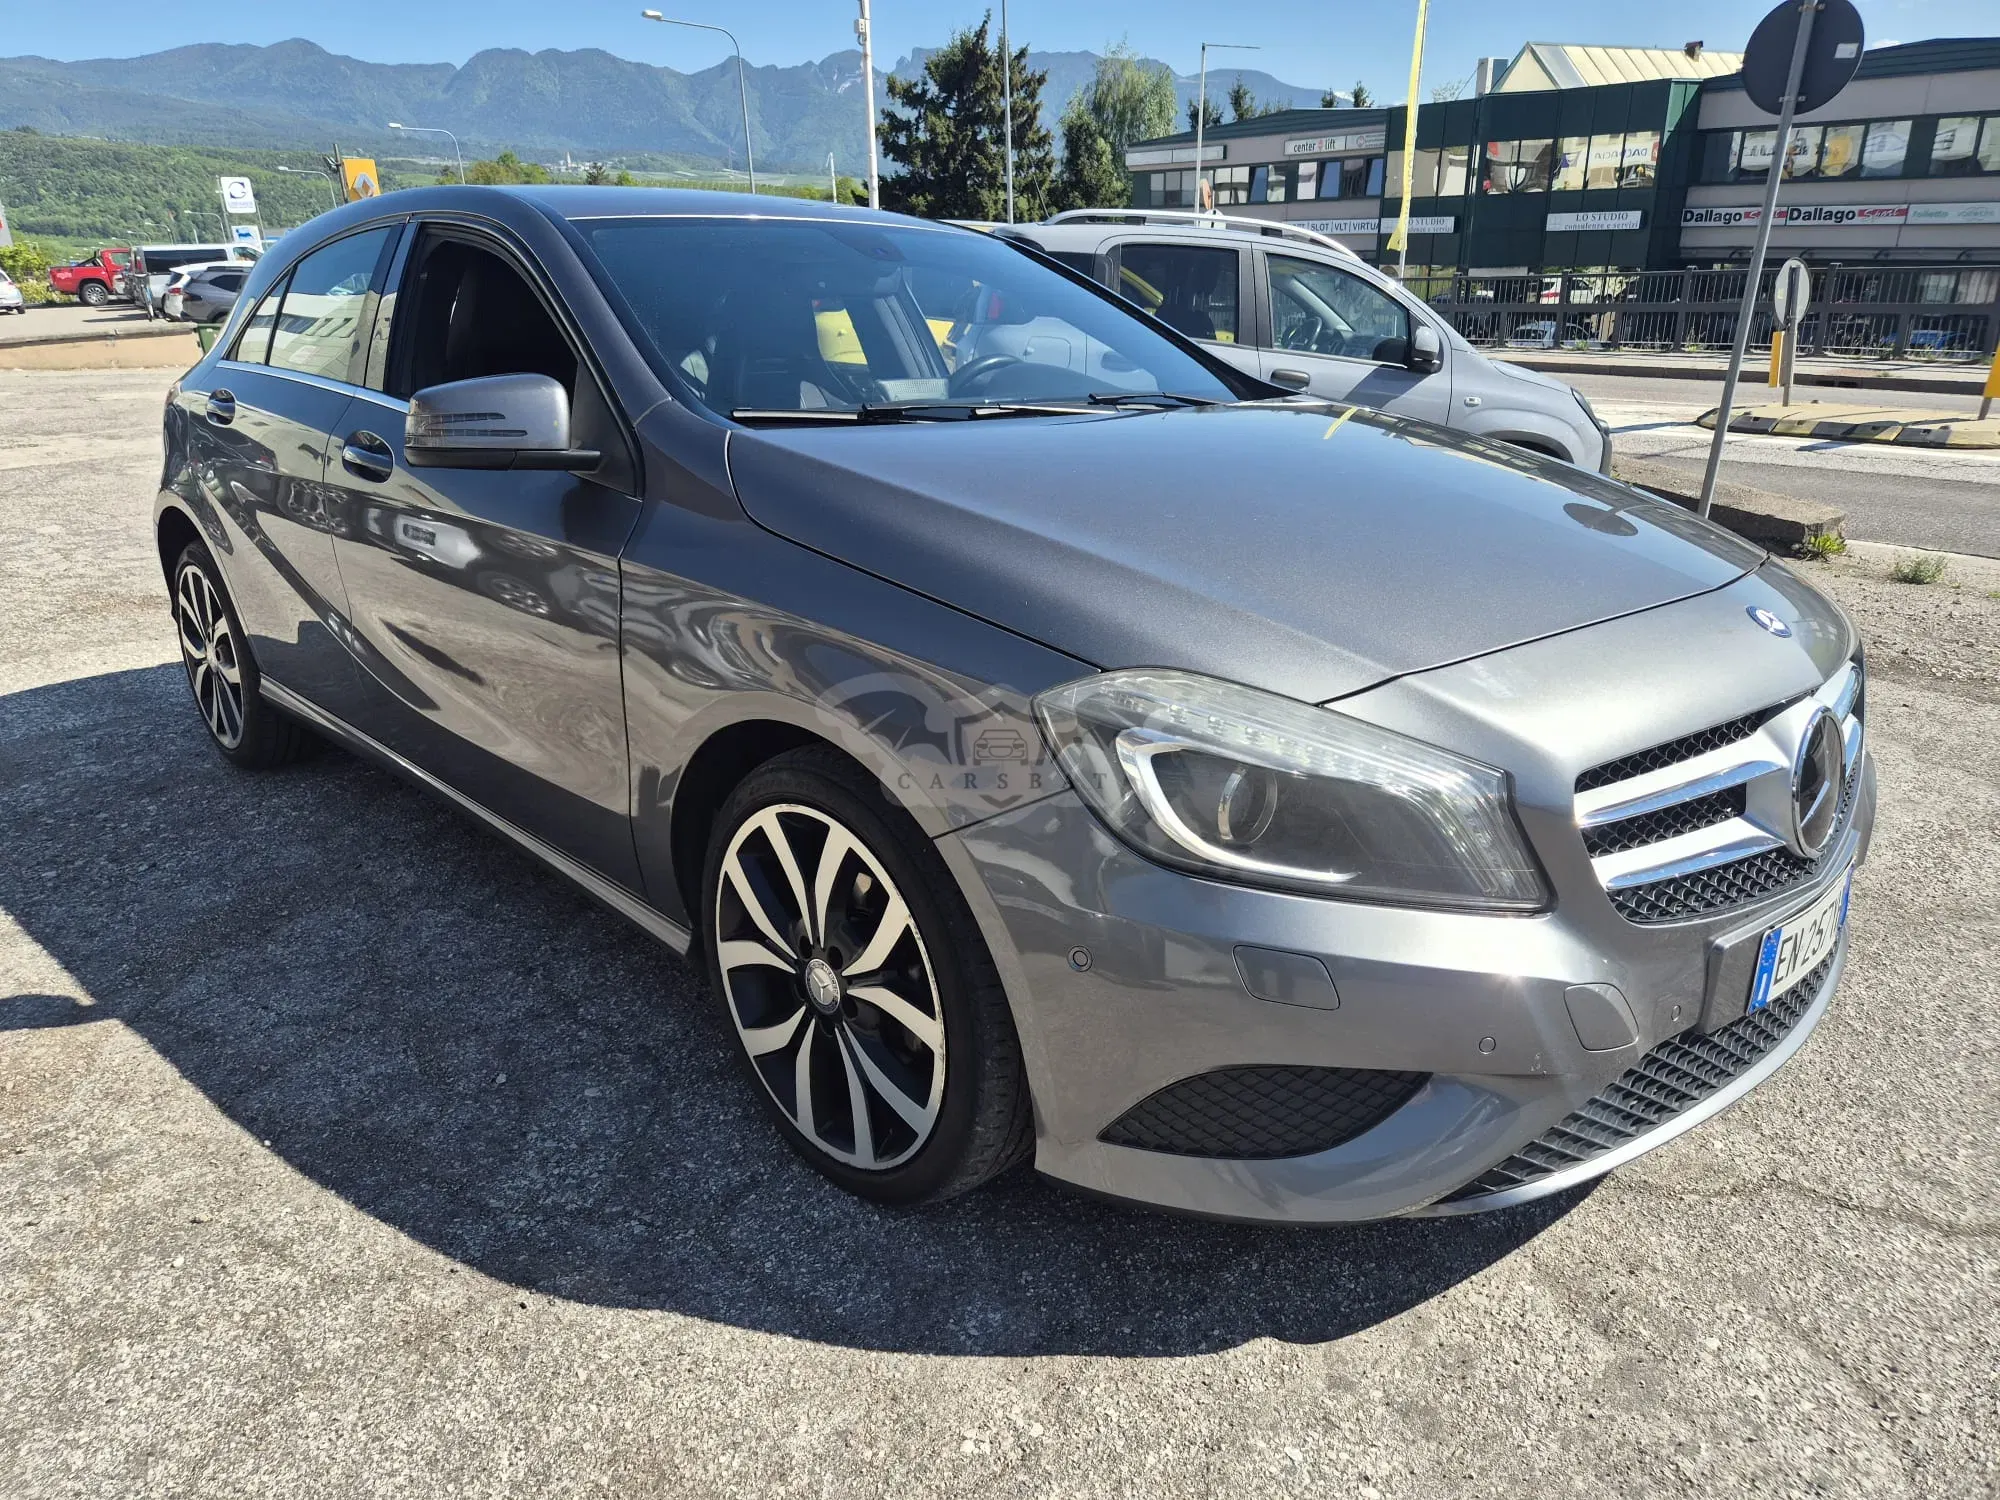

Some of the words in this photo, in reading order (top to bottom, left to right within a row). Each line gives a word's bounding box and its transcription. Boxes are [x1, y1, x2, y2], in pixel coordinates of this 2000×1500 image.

[1294, 142, 1316, 153] center
[1325, 139, 1336, 151] lift
[1576, 213, 1588, 222] LO
[1591, 212, 1629, 222] STUDIO
[1683, 209, 1743, 225] Dallago
[1788, 207, 1856, 224] Dallago
[1311, 223, 1329, 232] SLOT
[1332, 223, 1347, 232] VLT
